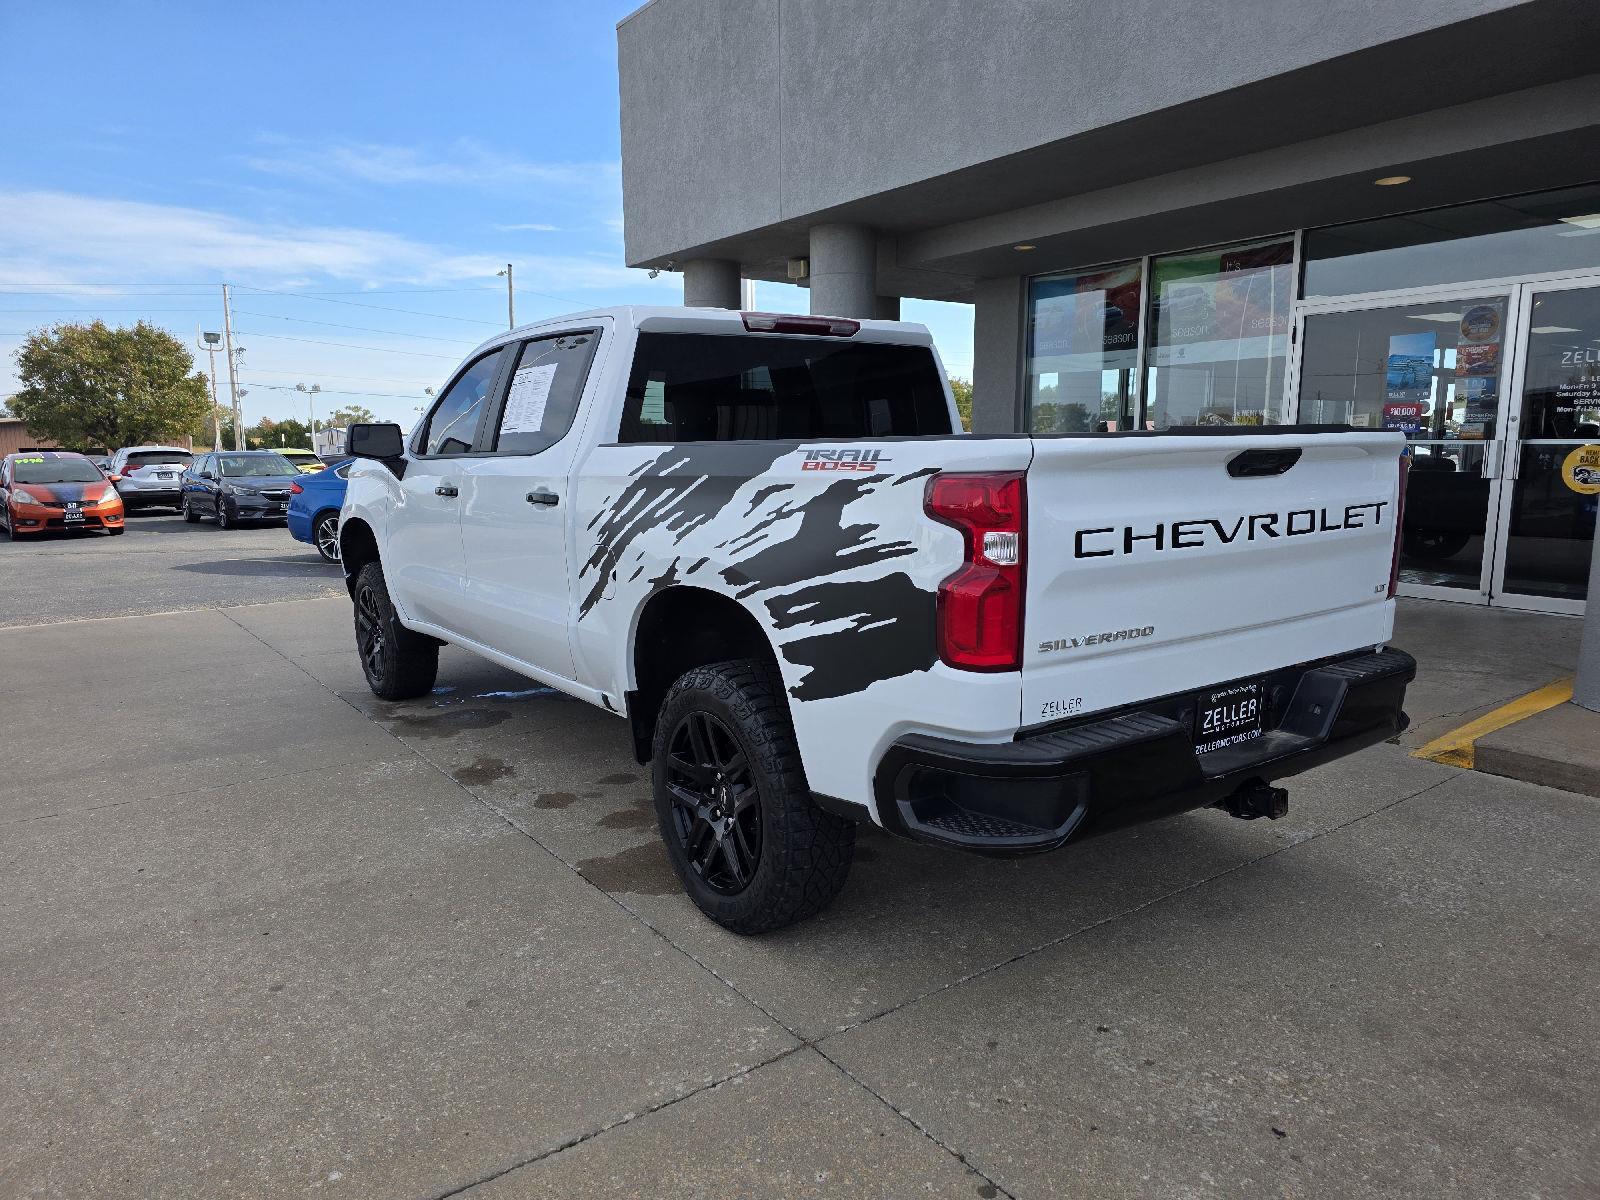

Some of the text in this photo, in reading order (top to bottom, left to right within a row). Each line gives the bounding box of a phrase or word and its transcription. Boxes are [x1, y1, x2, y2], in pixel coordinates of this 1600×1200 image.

[1103, 332, 1136, 345] season.
[797, 449, 893, 462] TRAIL
[802, 461, 878, 472] BOSS
[1074, 501, 1388, 559] CHEVROLET
[1038, 626, 1155, 653] SILVERADO
[1041, 697, 1082, 715] ZELLER
[1203, 698, 1257, 729] ZELLER
[1195, 728, 1262, 755] ZELLERMOTORS.COM
